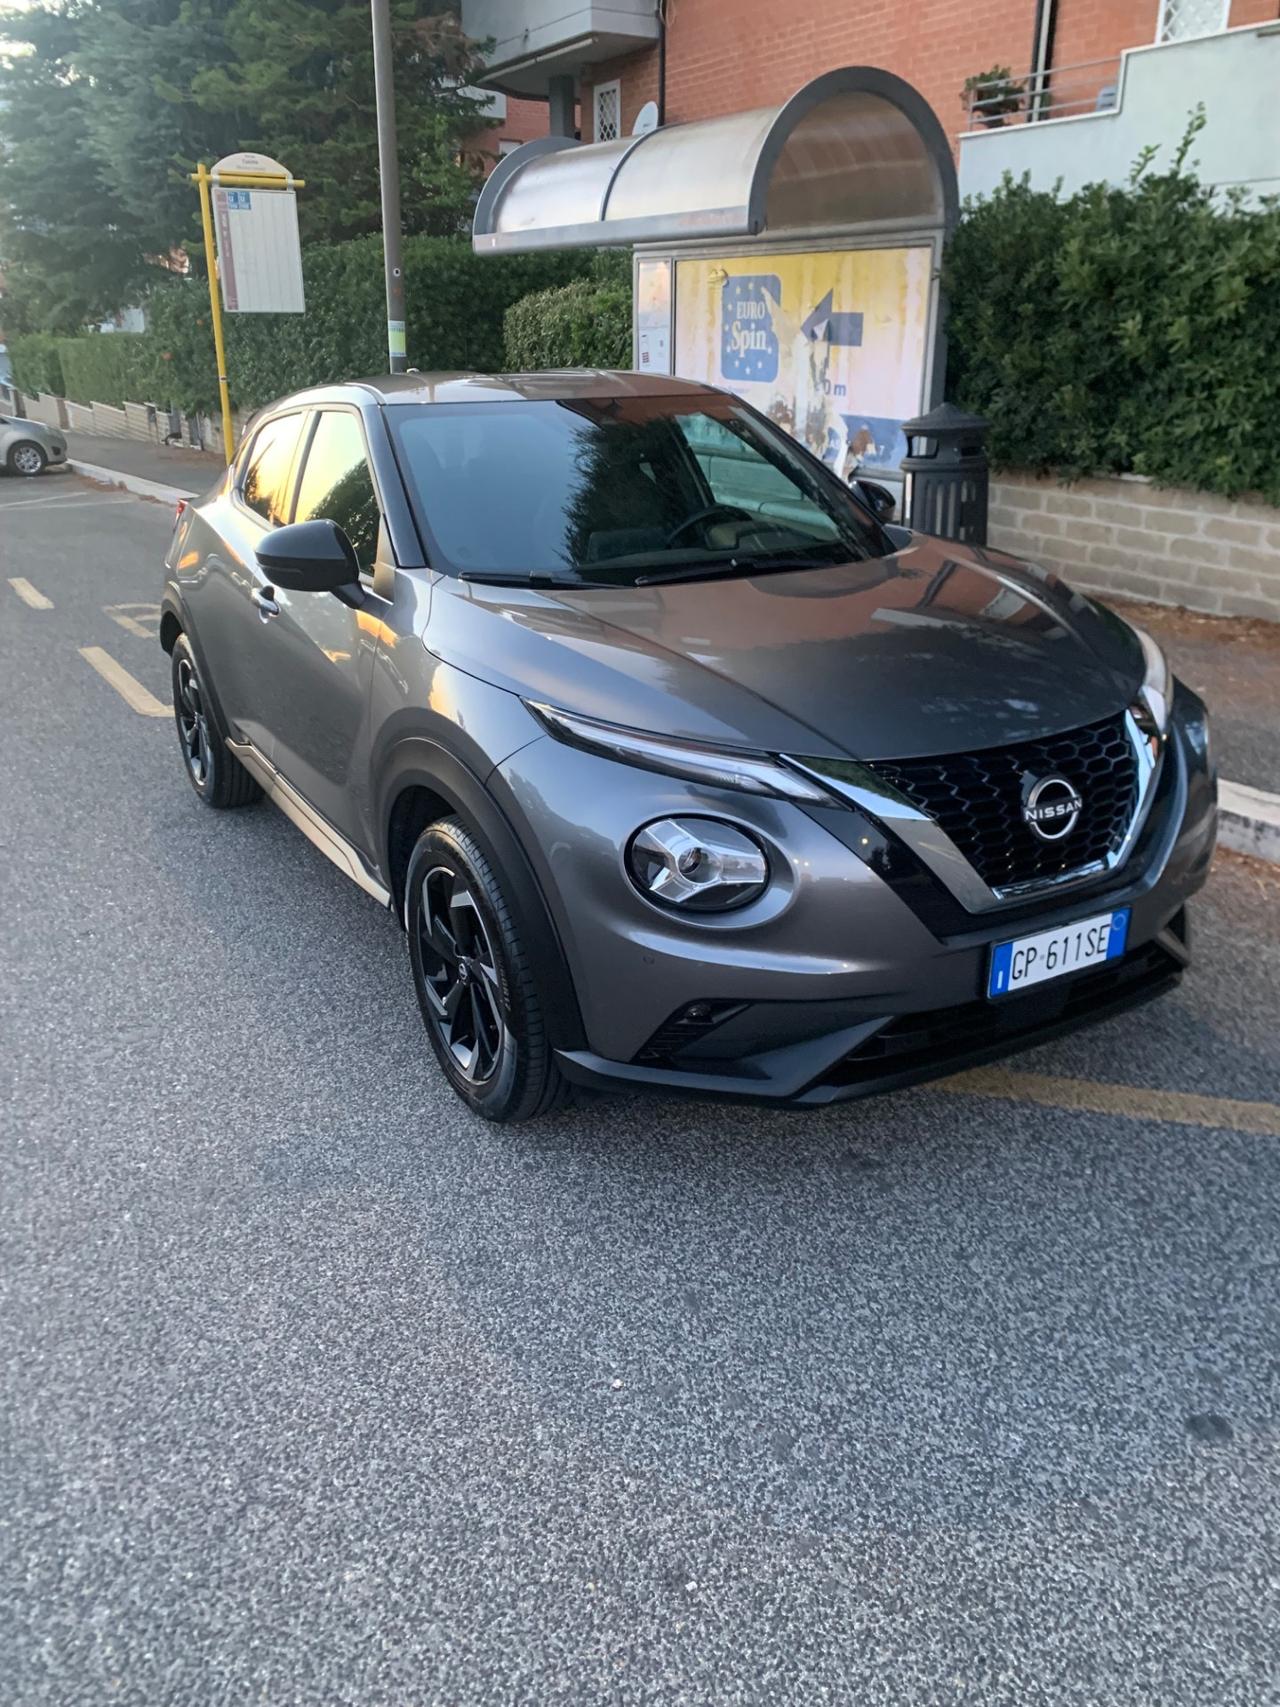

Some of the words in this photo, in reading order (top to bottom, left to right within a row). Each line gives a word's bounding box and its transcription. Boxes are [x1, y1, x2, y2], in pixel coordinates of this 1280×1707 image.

[736, 301, 766, 320] EURO
[731, 320, 768, 358] Spin
[1025, 799, 1082, 820] NISSAN
[1011, 946, 1038, 980] GP
[1046, 923, 1112, 970] 611SE
